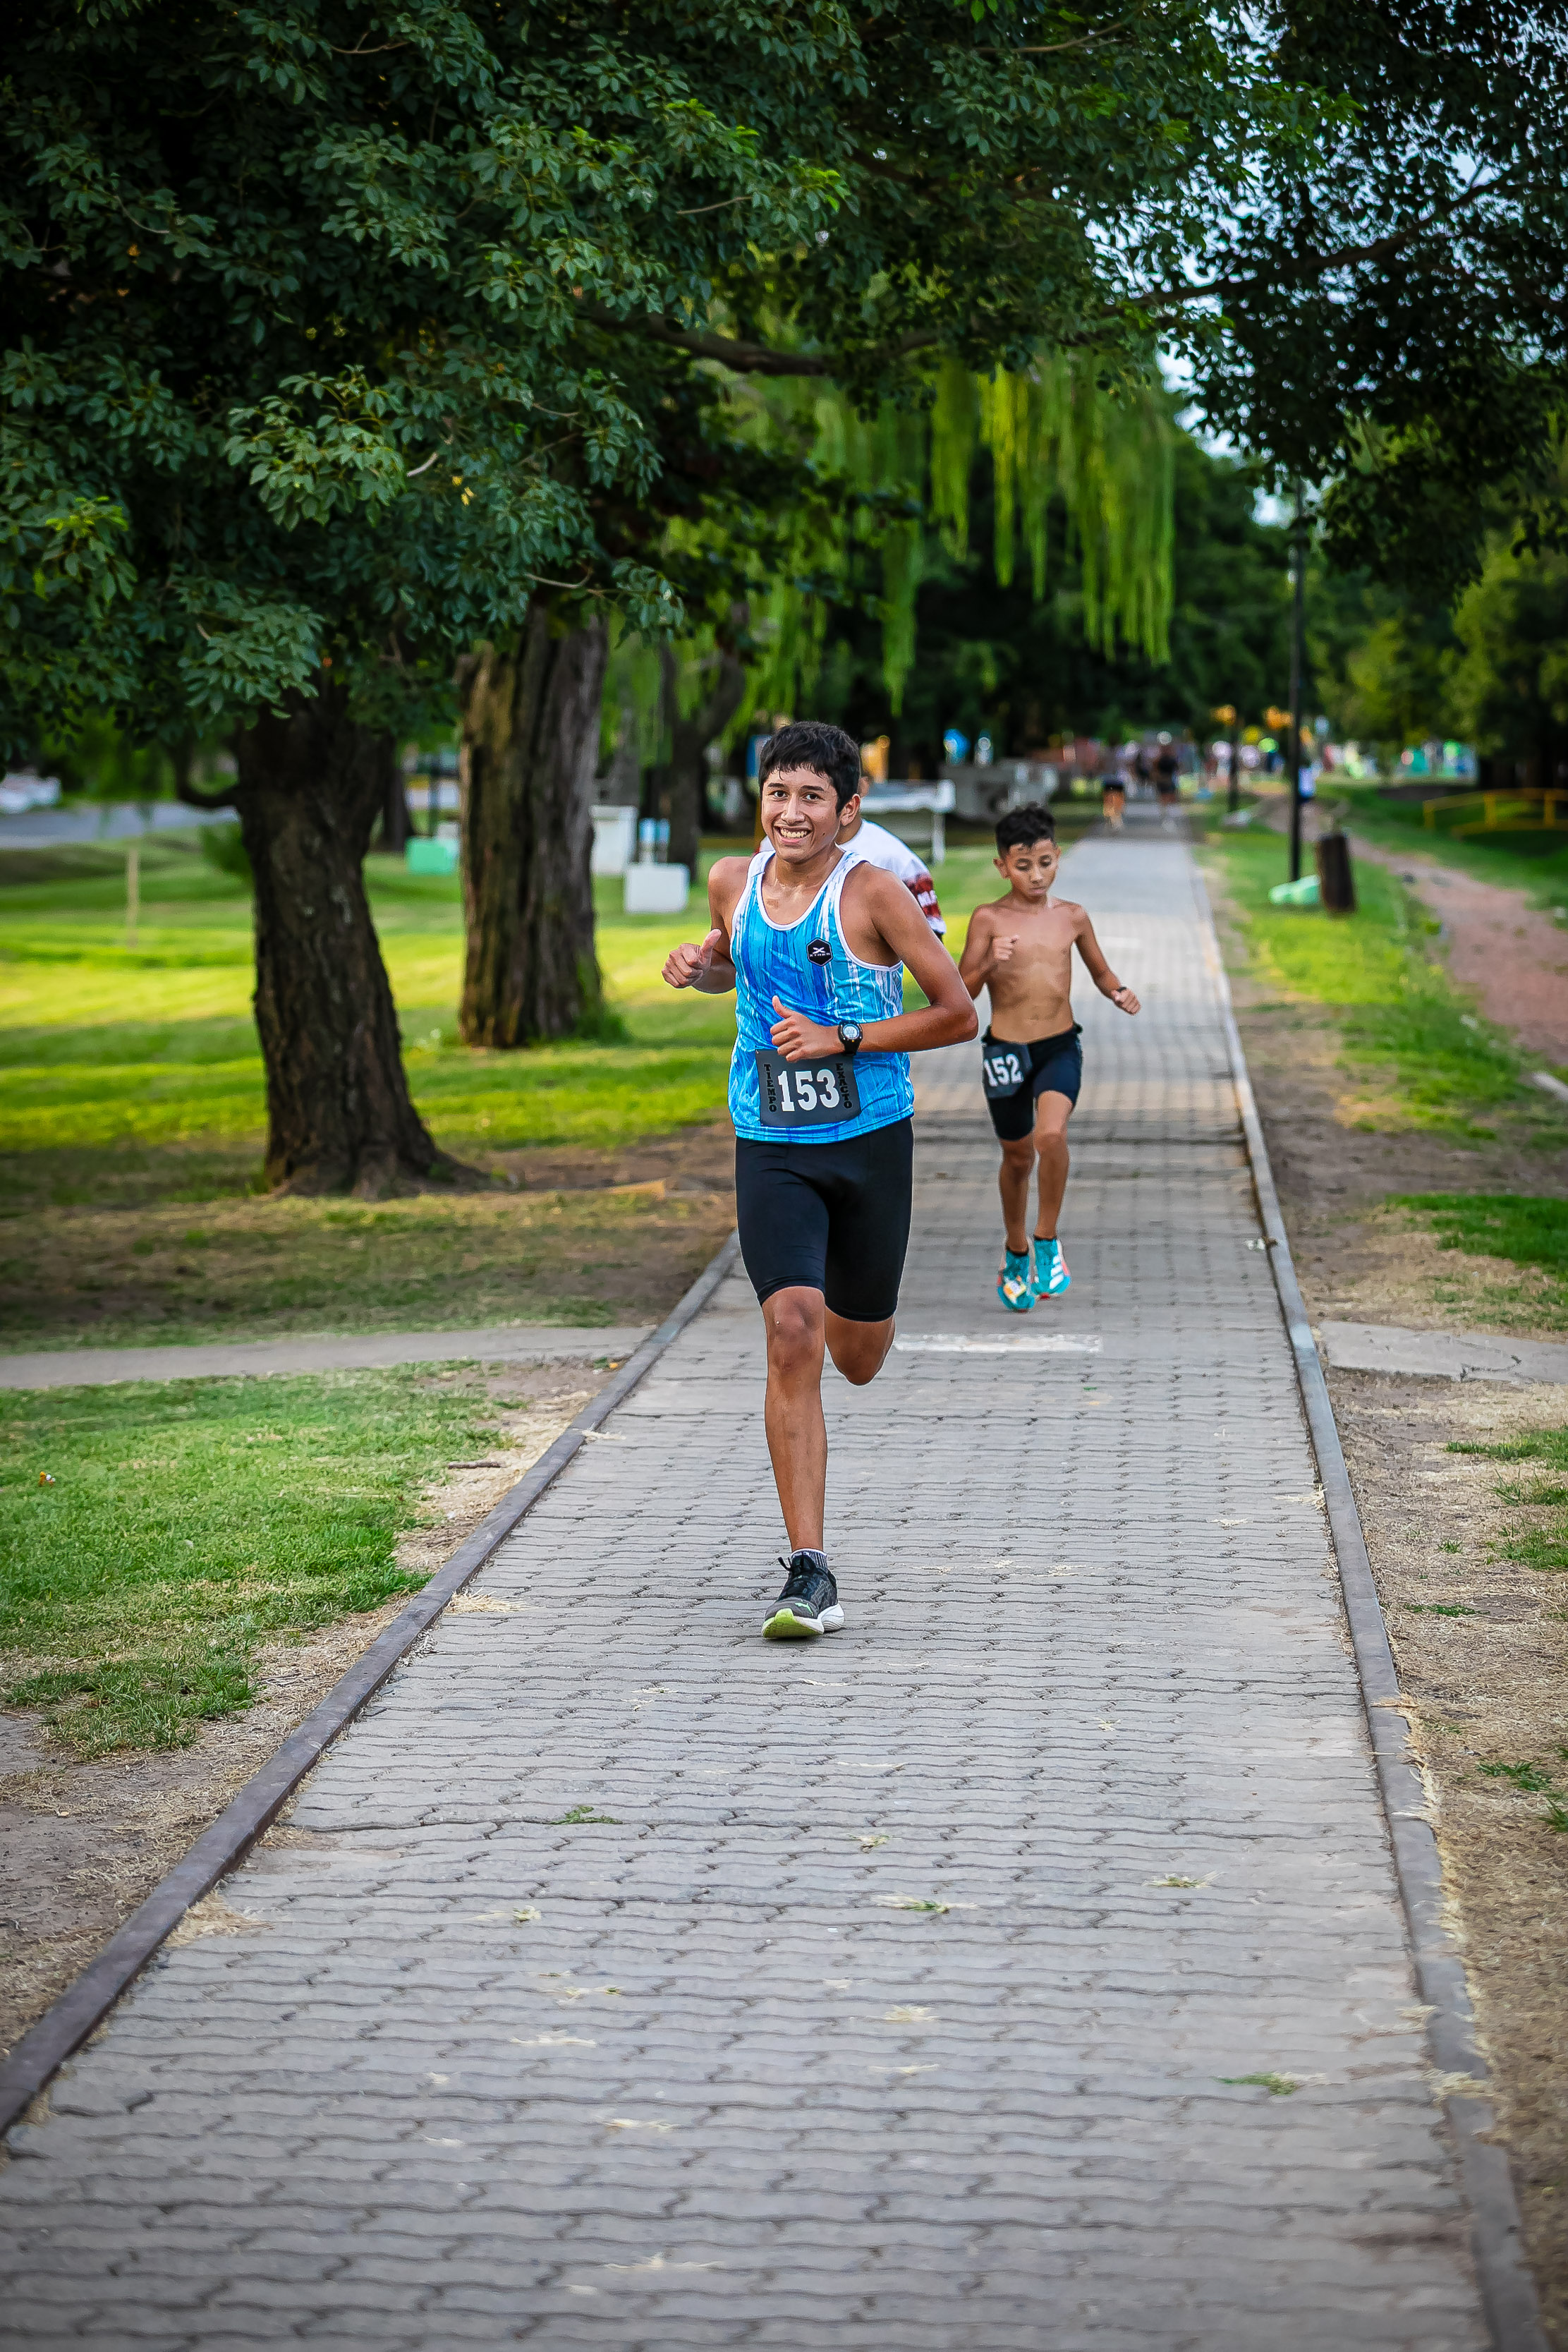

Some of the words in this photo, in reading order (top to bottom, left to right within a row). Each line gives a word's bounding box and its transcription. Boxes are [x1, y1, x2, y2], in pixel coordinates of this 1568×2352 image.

[763, 1063, 777, 1113] TIEMPO
[777, 1069, 840, 1112] 153
[835, 1062, 853, 1109] EXACTO
[983, 1053, 1024, 1087] 152
